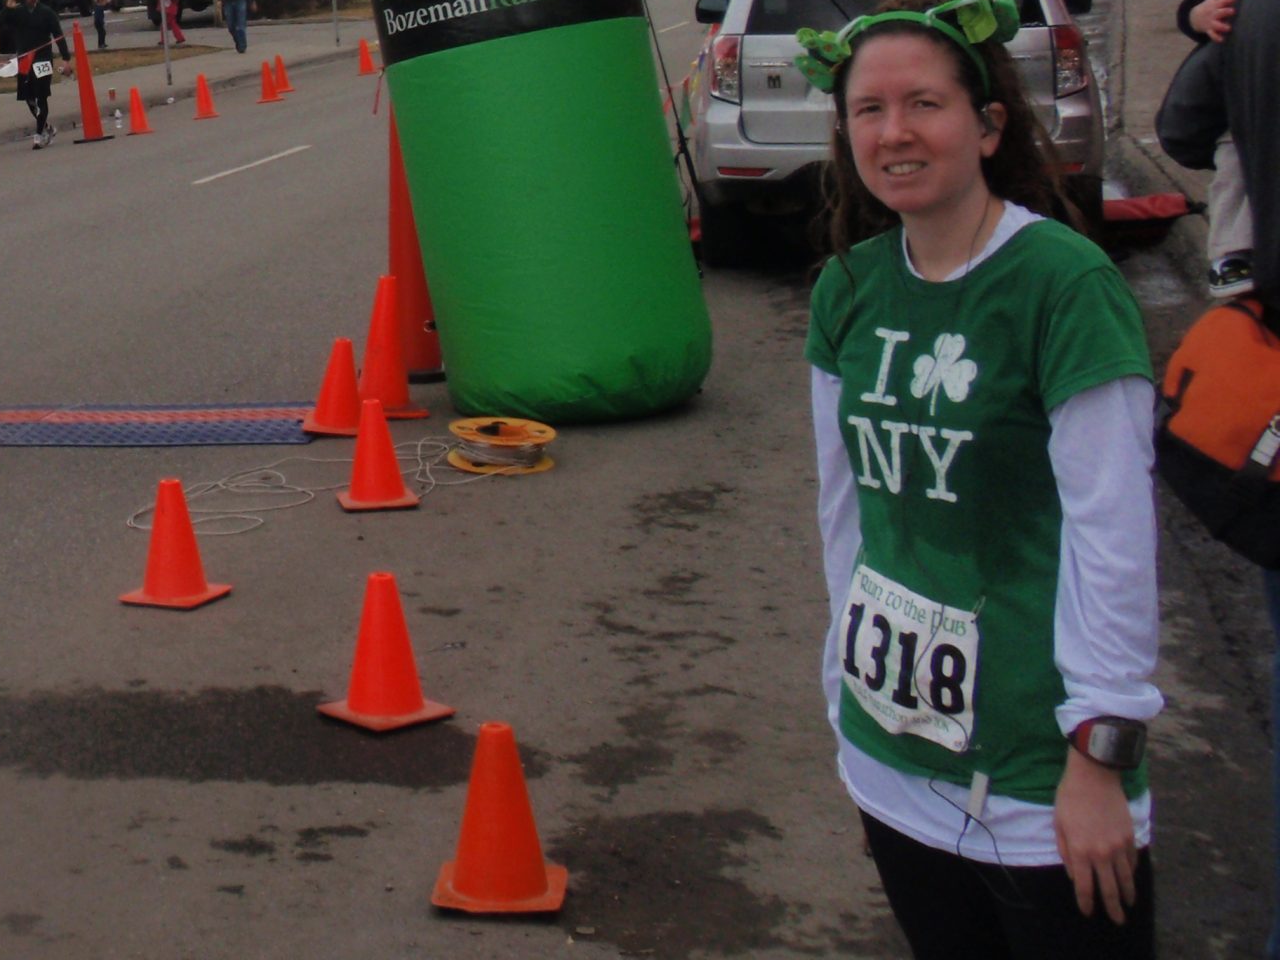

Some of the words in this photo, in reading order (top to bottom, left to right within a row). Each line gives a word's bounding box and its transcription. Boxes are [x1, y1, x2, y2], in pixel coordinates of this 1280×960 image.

[860, 327, 910, 406] I
[847, 415, 974, 503] NY
[843, 602, 967, 715] 1318
